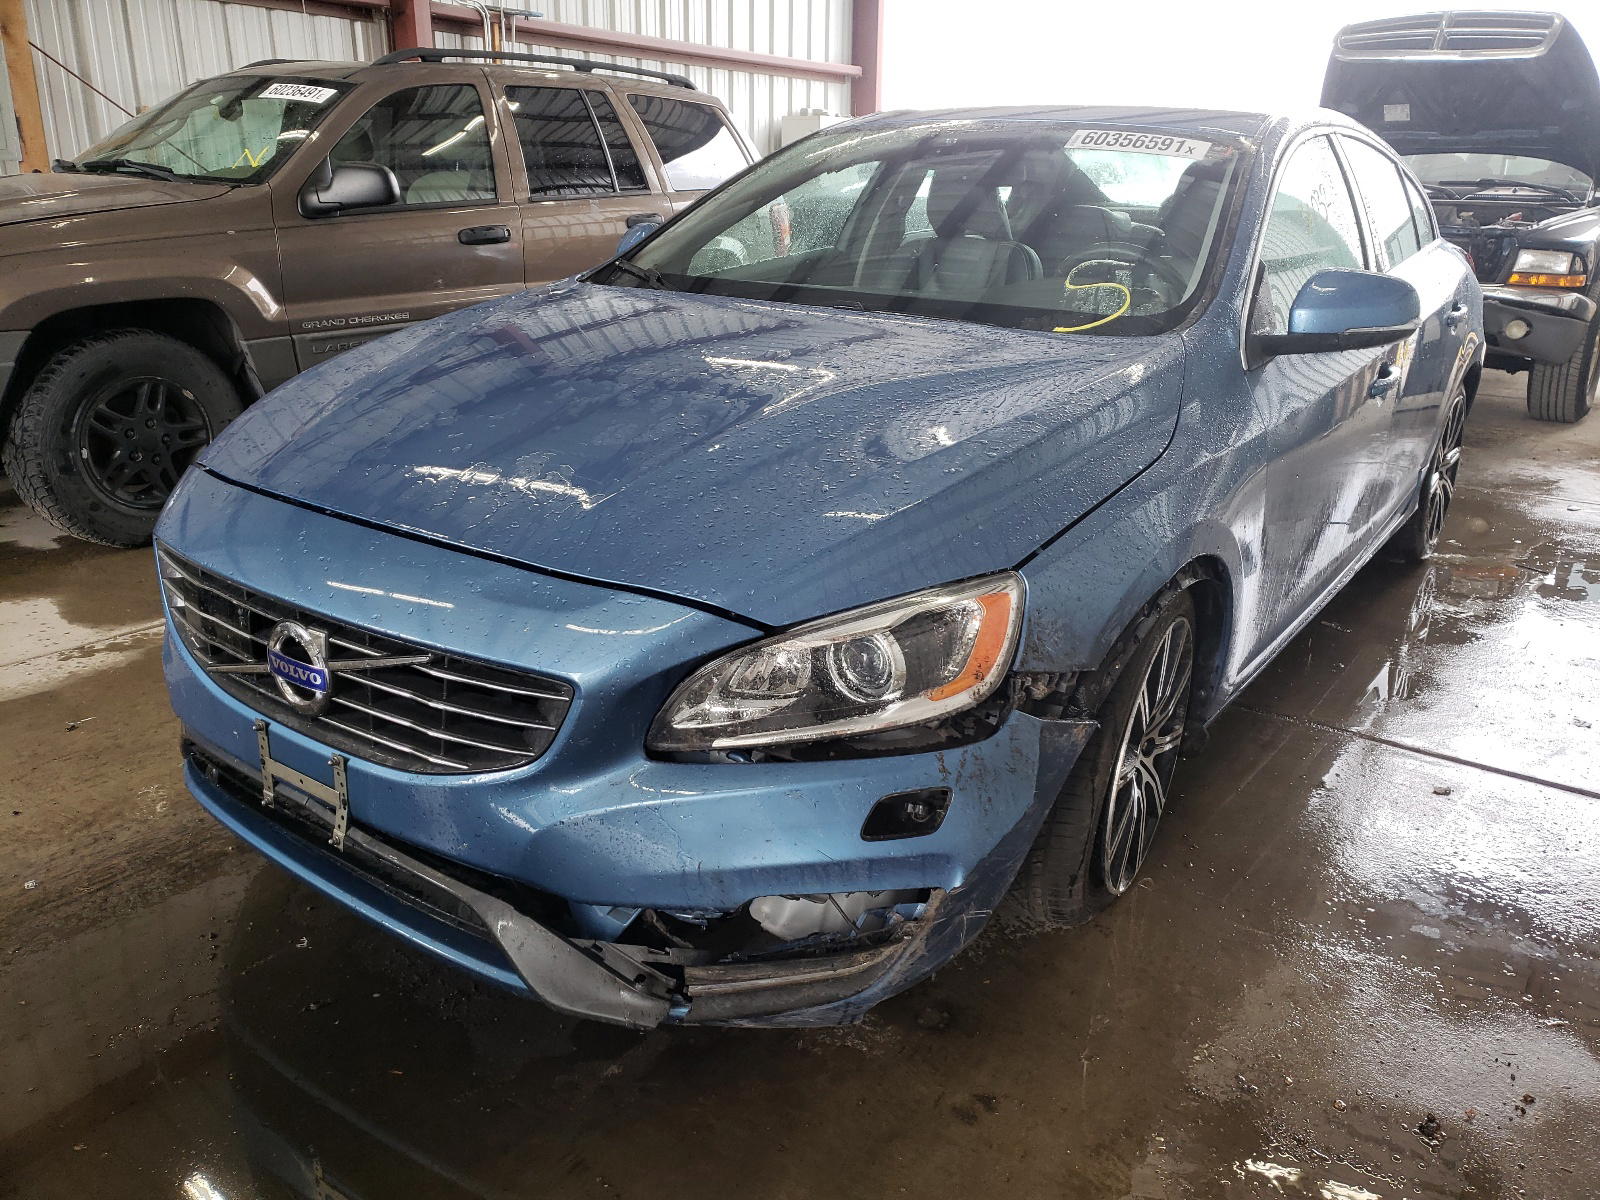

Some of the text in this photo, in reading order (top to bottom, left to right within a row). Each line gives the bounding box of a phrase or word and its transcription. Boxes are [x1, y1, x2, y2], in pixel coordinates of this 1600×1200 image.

[302, 311, 410, 329] GRAND CHEROKEE
[269, 654, 322, 685] VOLVO
